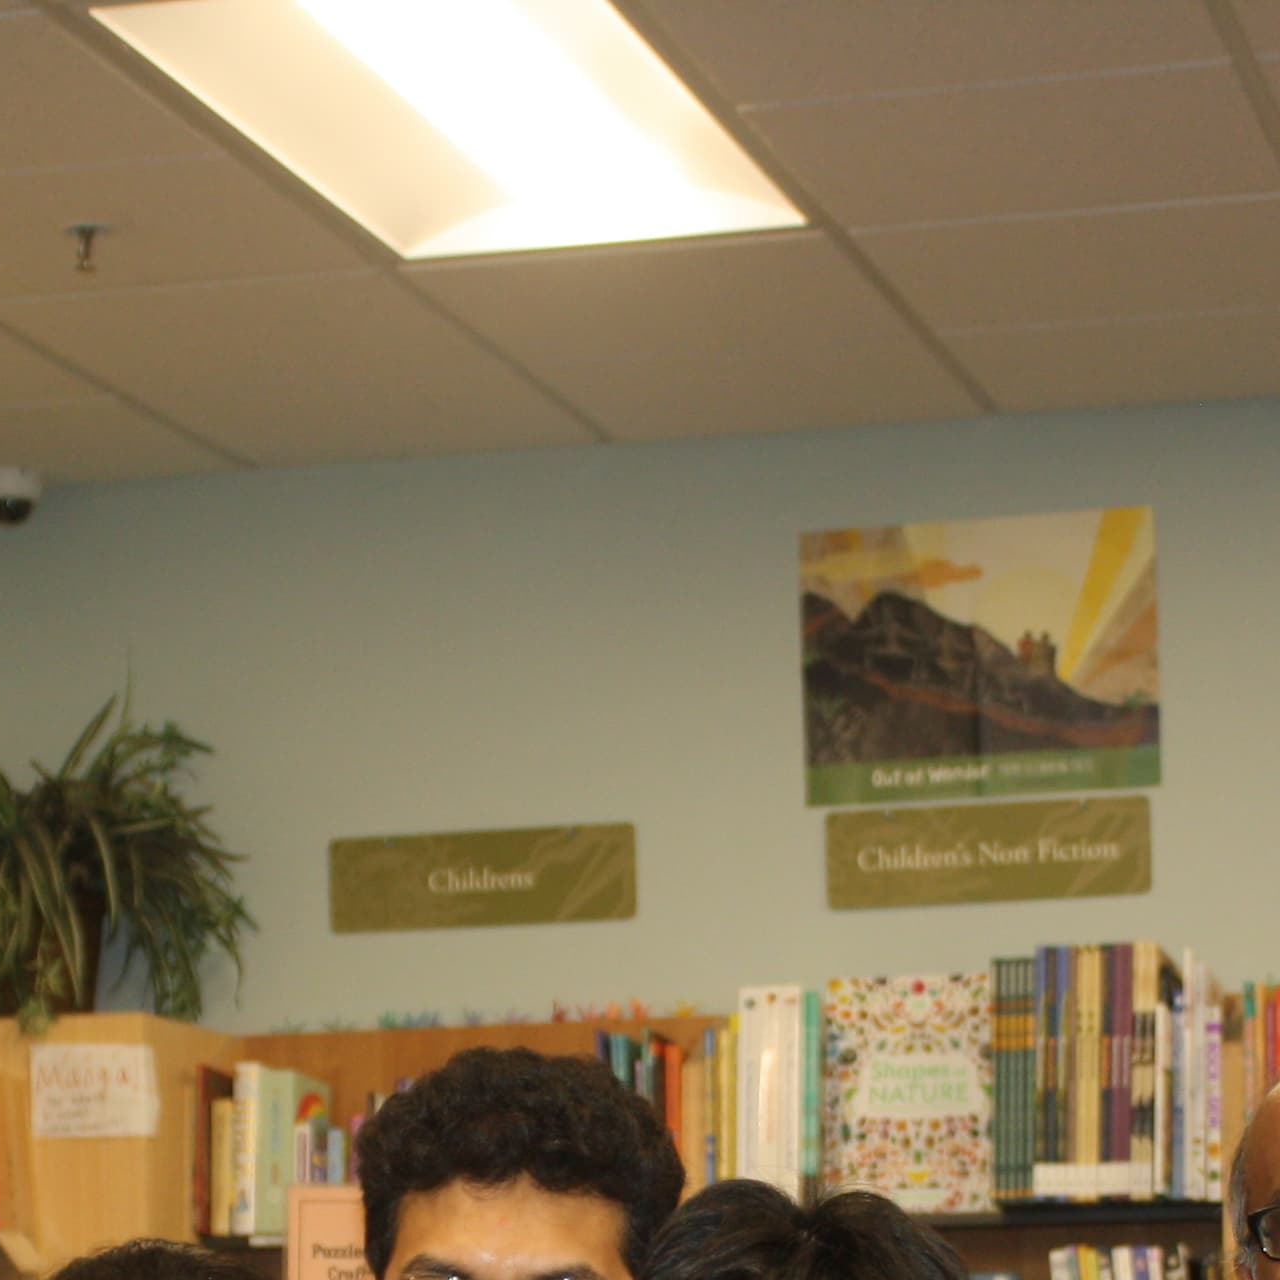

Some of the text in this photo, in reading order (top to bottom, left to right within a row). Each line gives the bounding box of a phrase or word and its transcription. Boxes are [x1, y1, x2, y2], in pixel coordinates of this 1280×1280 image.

[856, 836, 1120, 872] Children's Non Fiction
[869, 1081, 969, 1104] NATURE
[311, 1243, 365, 1260] Puzzle
